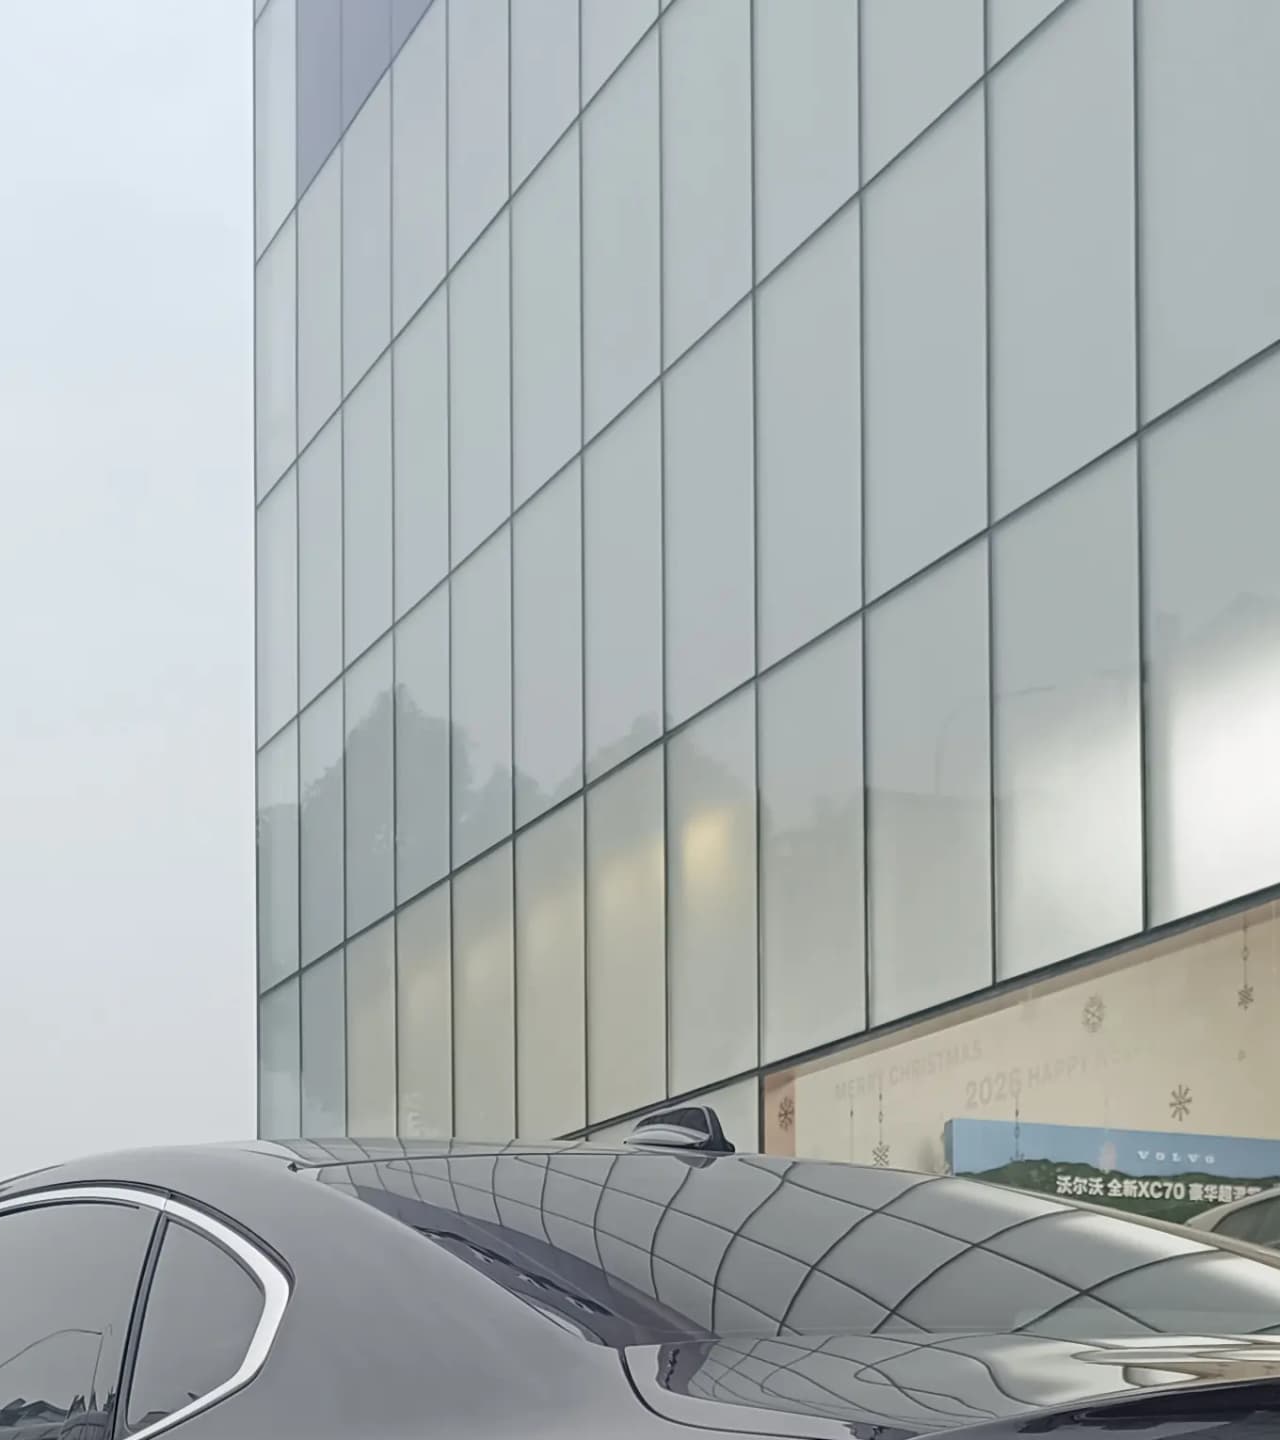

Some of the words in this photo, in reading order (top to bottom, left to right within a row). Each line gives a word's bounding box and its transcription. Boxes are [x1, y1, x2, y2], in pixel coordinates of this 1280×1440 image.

[965, 1070, 1023, 1109] 2026
[1137, 1151, 1216, 1164] VOLVO
[1055, 1175, 1105, 1196] 沃尔沃
[1107, 1177, 1186, 1201] 全新XC70
